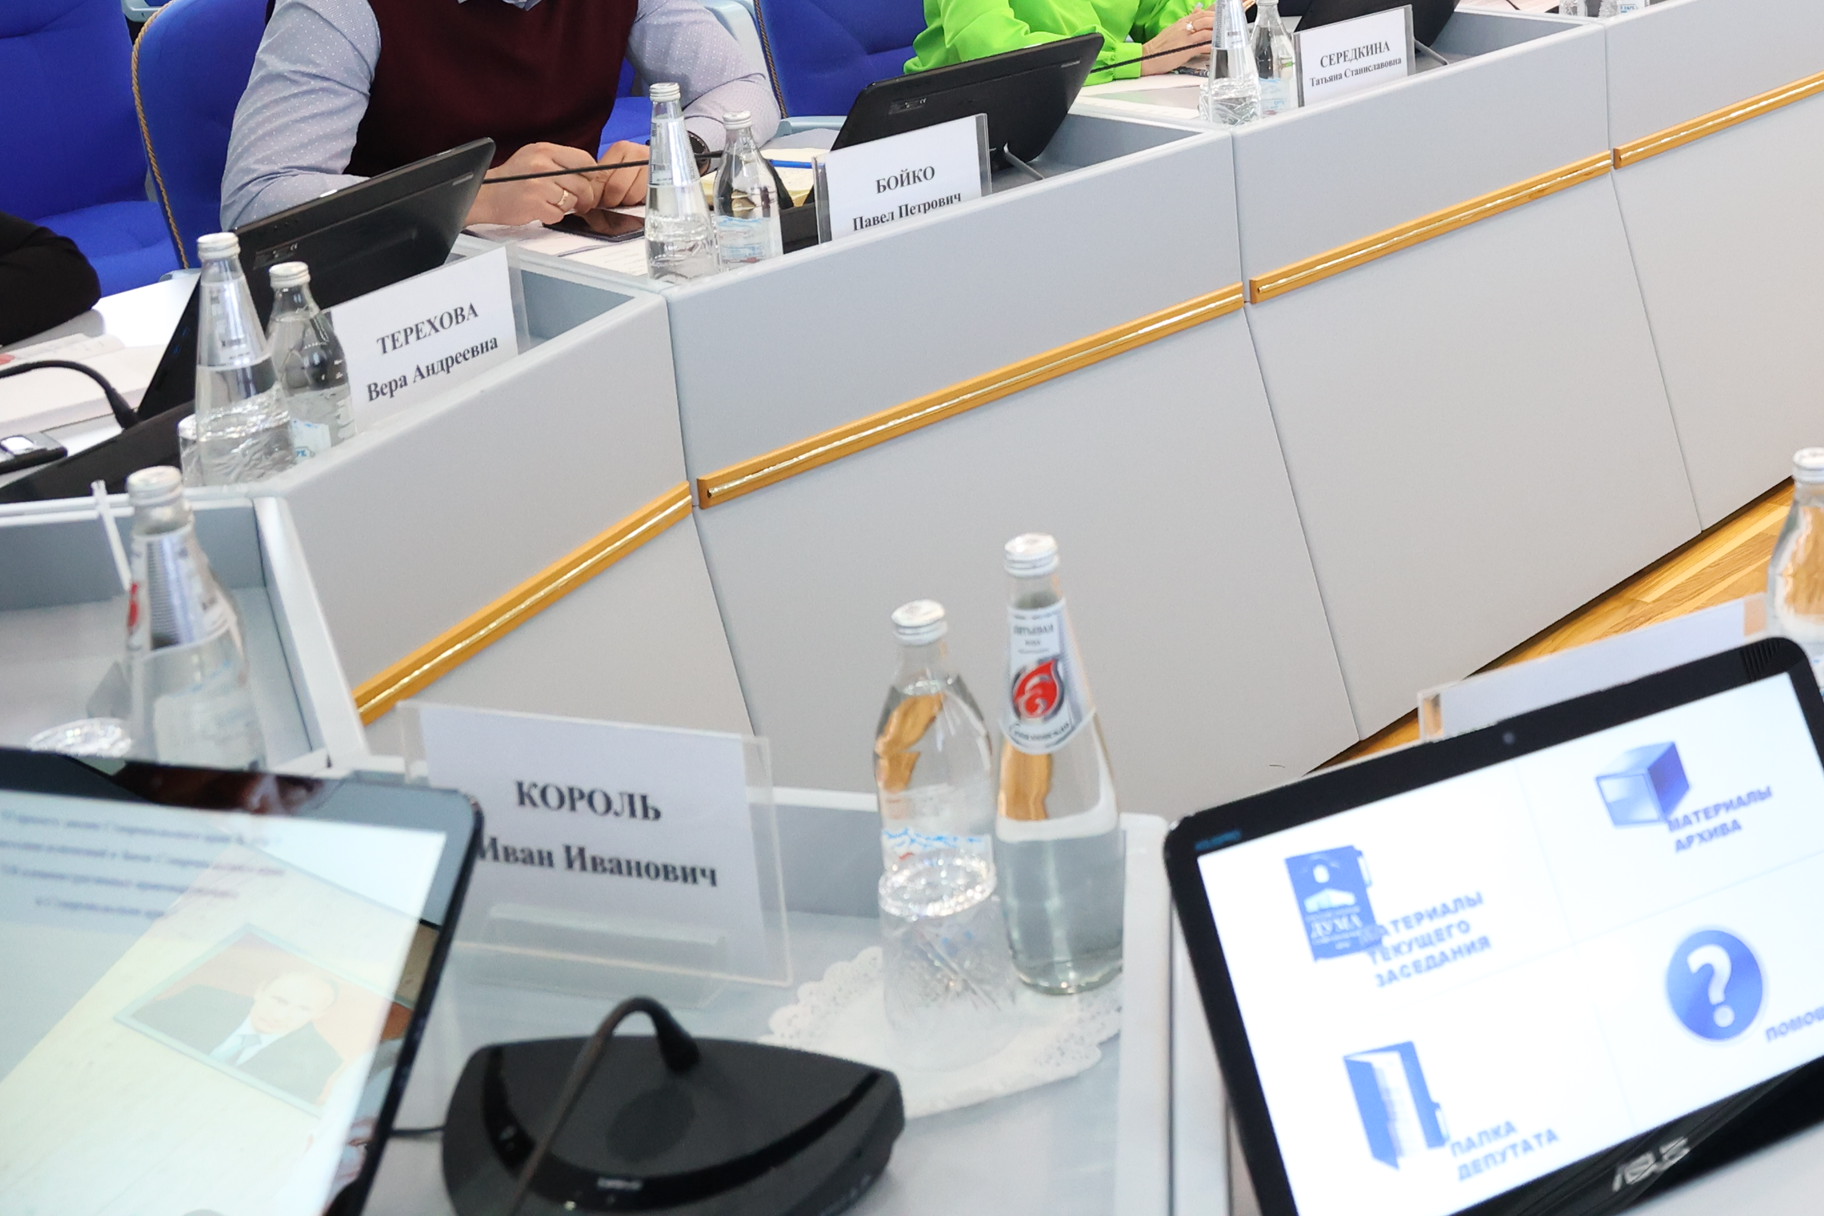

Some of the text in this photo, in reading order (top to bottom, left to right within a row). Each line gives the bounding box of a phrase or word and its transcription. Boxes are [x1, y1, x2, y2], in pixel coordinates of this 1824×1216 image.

[1309, 57, 1402, 87] Татьяна Станиславовна
[1320, 40, 1391, 68] СЕРЕДКИНА
[875, 165, 936, 194] БОЙКО
[852, 192, 962, 231] Павел Петрович
[376, 301, 479, 356] ТЕРЕХОВА
[366, 336, 499, 402] Вера Андреевна
[515, 780, 662, 822] КОРОЛЬ
[1667, 785, 1773, 833] МАТЕРИАЛЫ
[1674, 818, 1743, 853] АРХИВА
[476, 836, 718, 887] Иван Иванович
[1366, 919, 1472, 966] ТЕКУЩЕГО
[1374, 935, 1494, 988] ЗАСЕДАНИЯ
[1457, 1127, 1560, 1182] ДЕПУТАТА
[1611, 1135, 1691, 1193] ASUS
